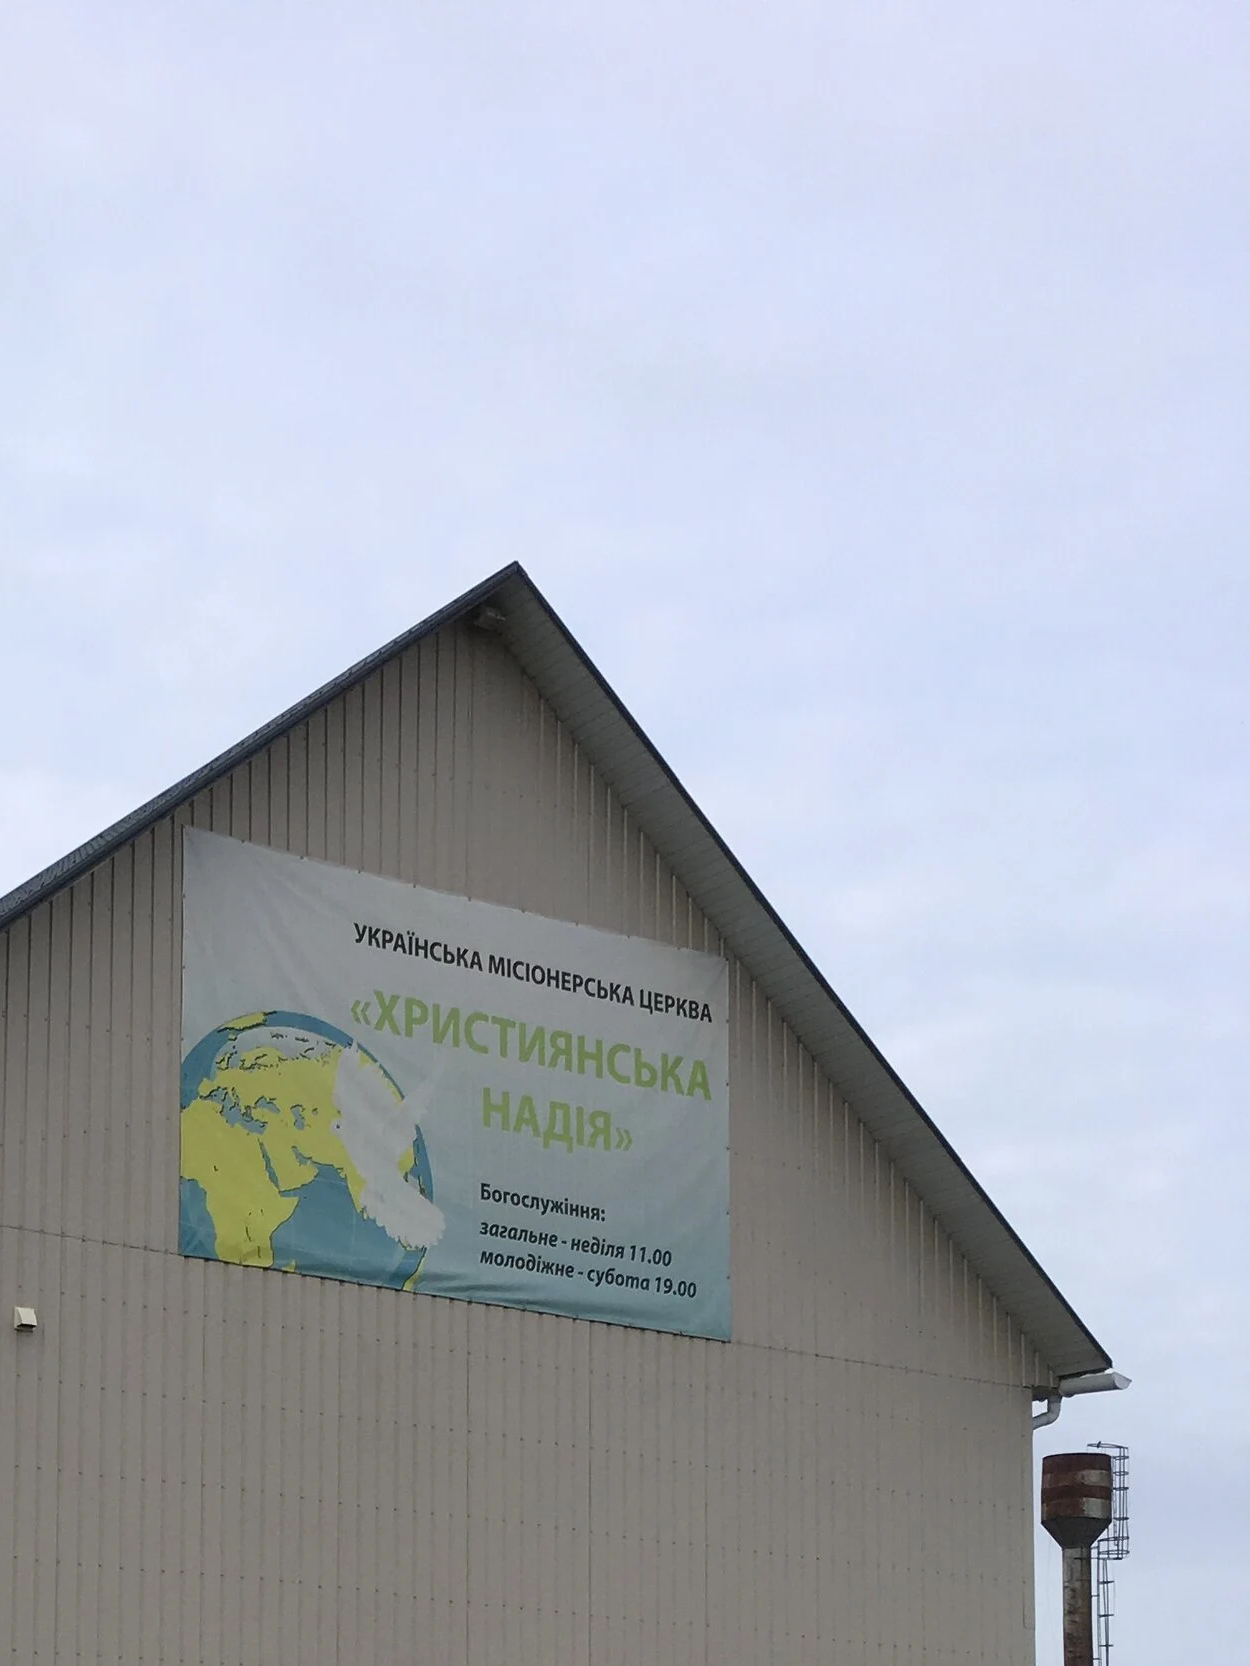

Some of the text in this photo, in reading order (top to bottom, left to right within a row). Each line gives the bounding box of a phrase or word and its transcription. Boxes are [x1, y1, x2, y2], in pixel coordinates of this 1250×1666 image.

[354, 922, 713, 1023] УКРАЇНСЬКА МІСІОНЕРСЬКА ЦЕРКВА
[351, 989, 712, 1101] «ХРИСТИЯНСЬКА
[482, 1086, 634, 1154] НАДІЯ»
[480, 1182, 606, 1222] Богослужіння:
[479, 1221, 559, 1248] загальне
[570, 1236, 626, 1260] неділя
[629, 1244, 672, 1267] 11.00
[479, 1250, 575, 1278] молодіжне
[586, 1267, 651, 1292] субота
[654, 1276, 697, 1298] 19.00
